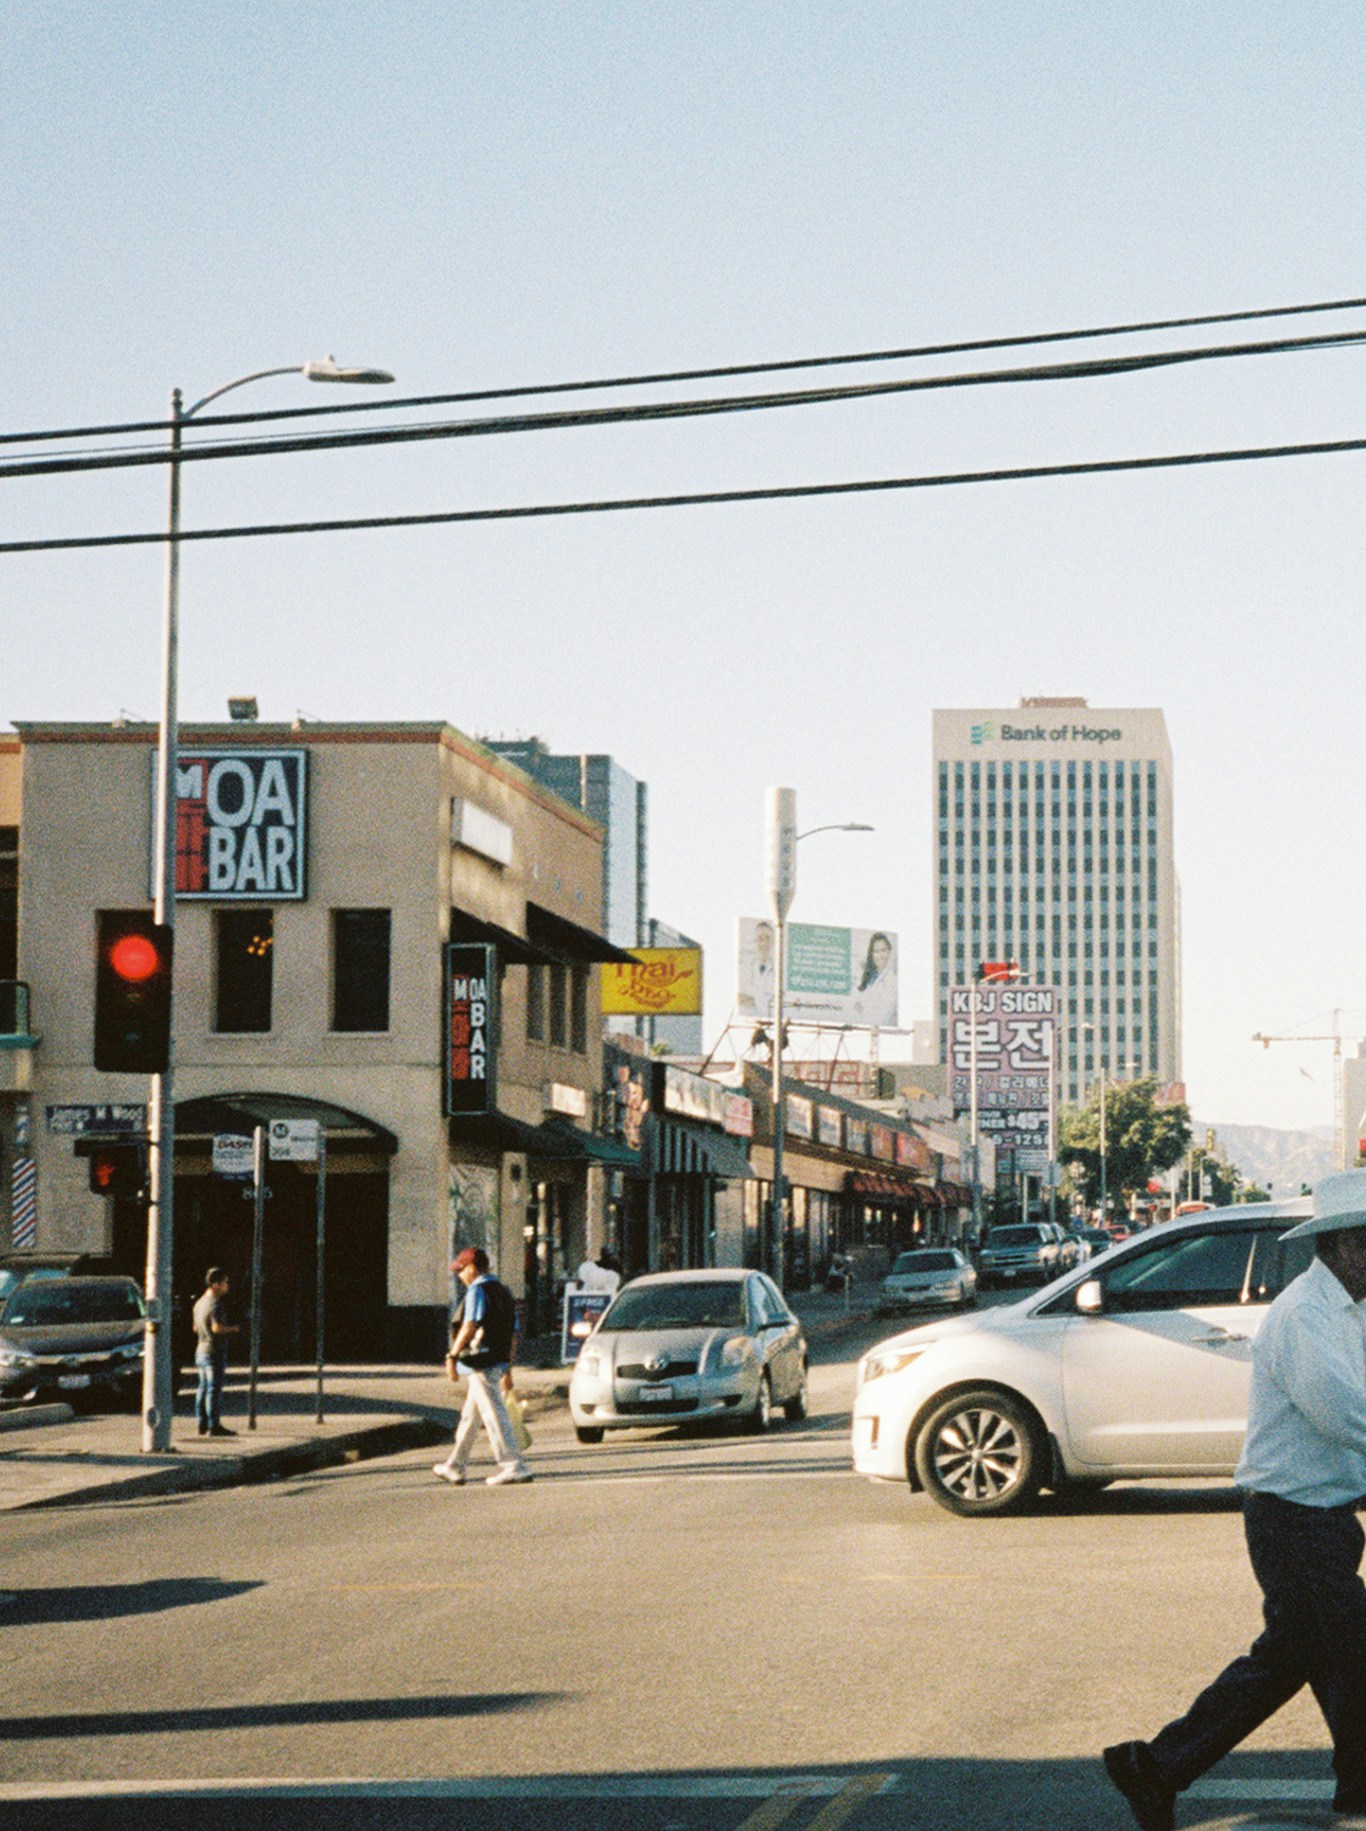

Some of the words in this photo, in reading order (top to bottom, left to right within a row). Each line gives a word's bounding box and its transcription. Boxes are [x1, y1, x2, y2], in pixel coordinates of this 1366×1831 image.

[1001, 724, 1046, 741] Bank
[1050, 724, 1068, 741] of
[1072, 724, 1121, 744] Hope
[175, 758, 296, 828] MOA
[208, 825, 296, 892] BAR
[454, 977, 487, 1001] MOA
[953, 990, 997, 1013] KBJ
[1001, 990, 1053, 1013] SIGN
[470, 1002, 486, 1080] BAR
[953, 1019, 1054, 1070] 본전
